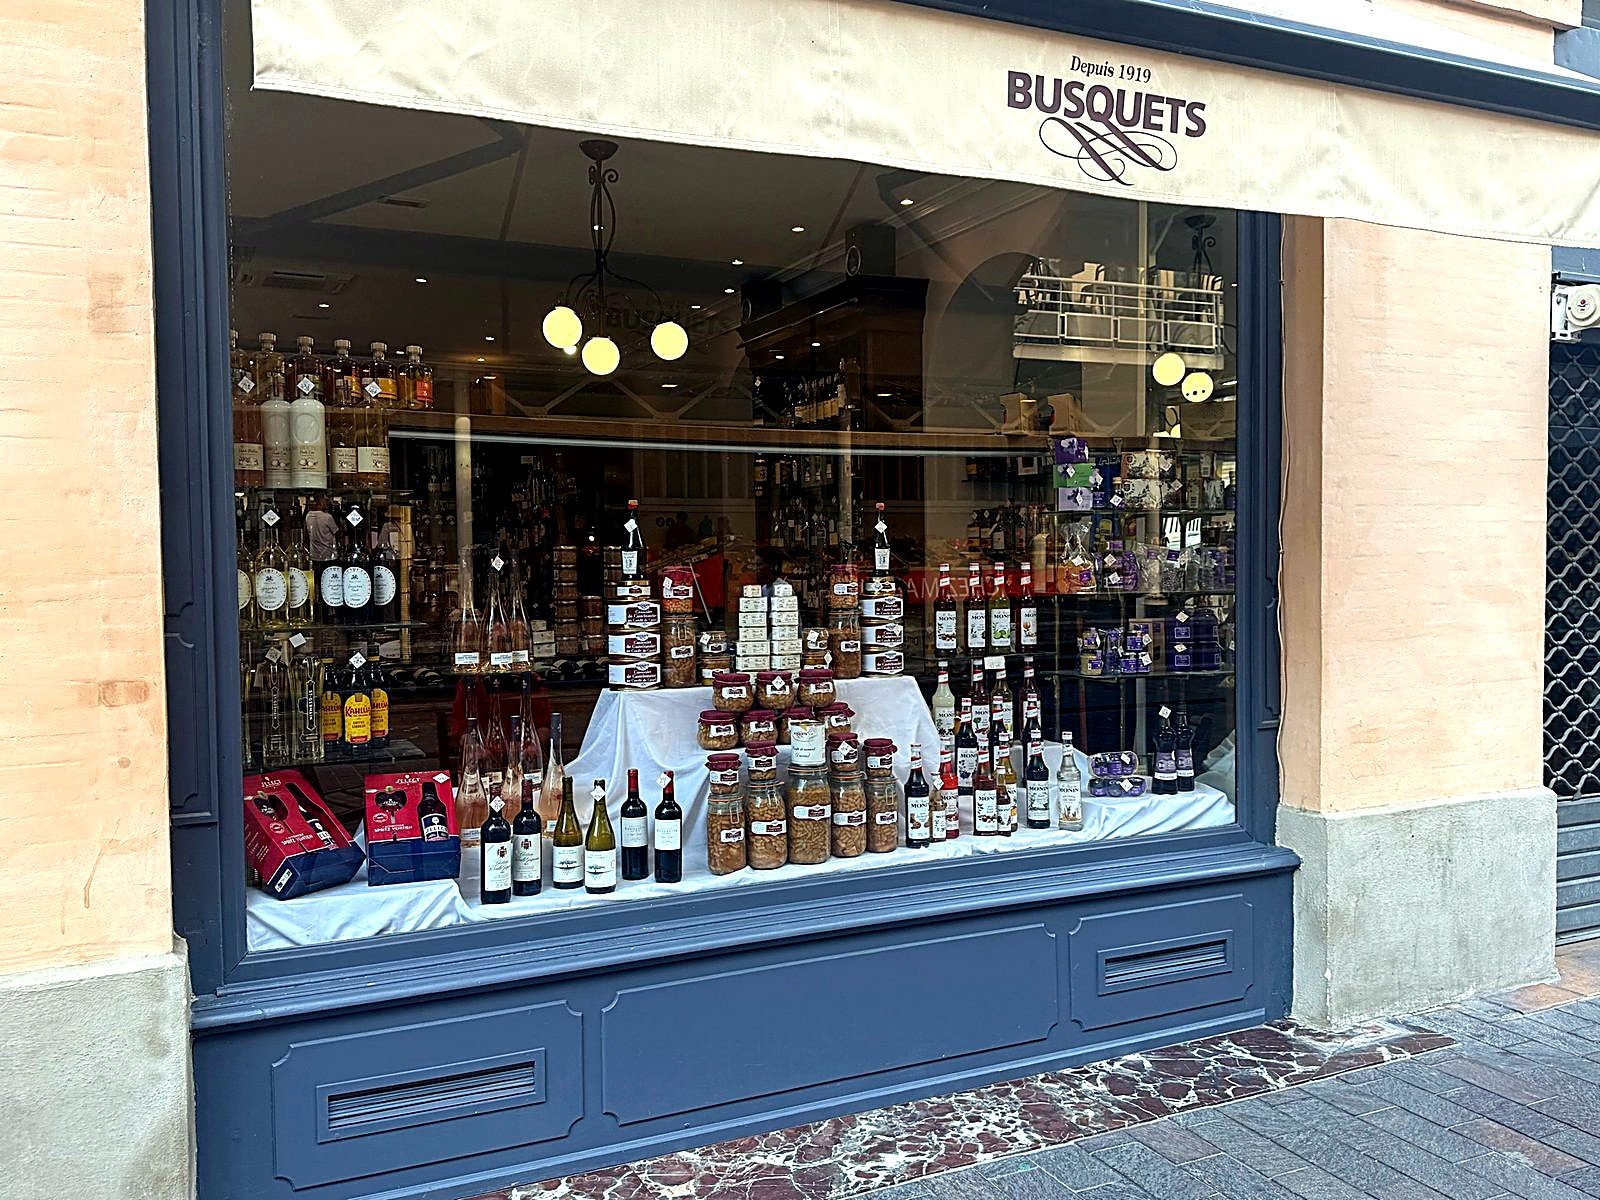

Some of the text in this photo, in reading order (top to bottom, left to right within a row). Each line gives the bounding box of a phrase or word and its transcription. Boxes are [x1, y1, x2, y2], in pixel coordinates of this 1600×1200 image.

[1070, 55, 1151, 83] Depuis 1919
[1007, 70, 1206, 137] BUSQUETS
